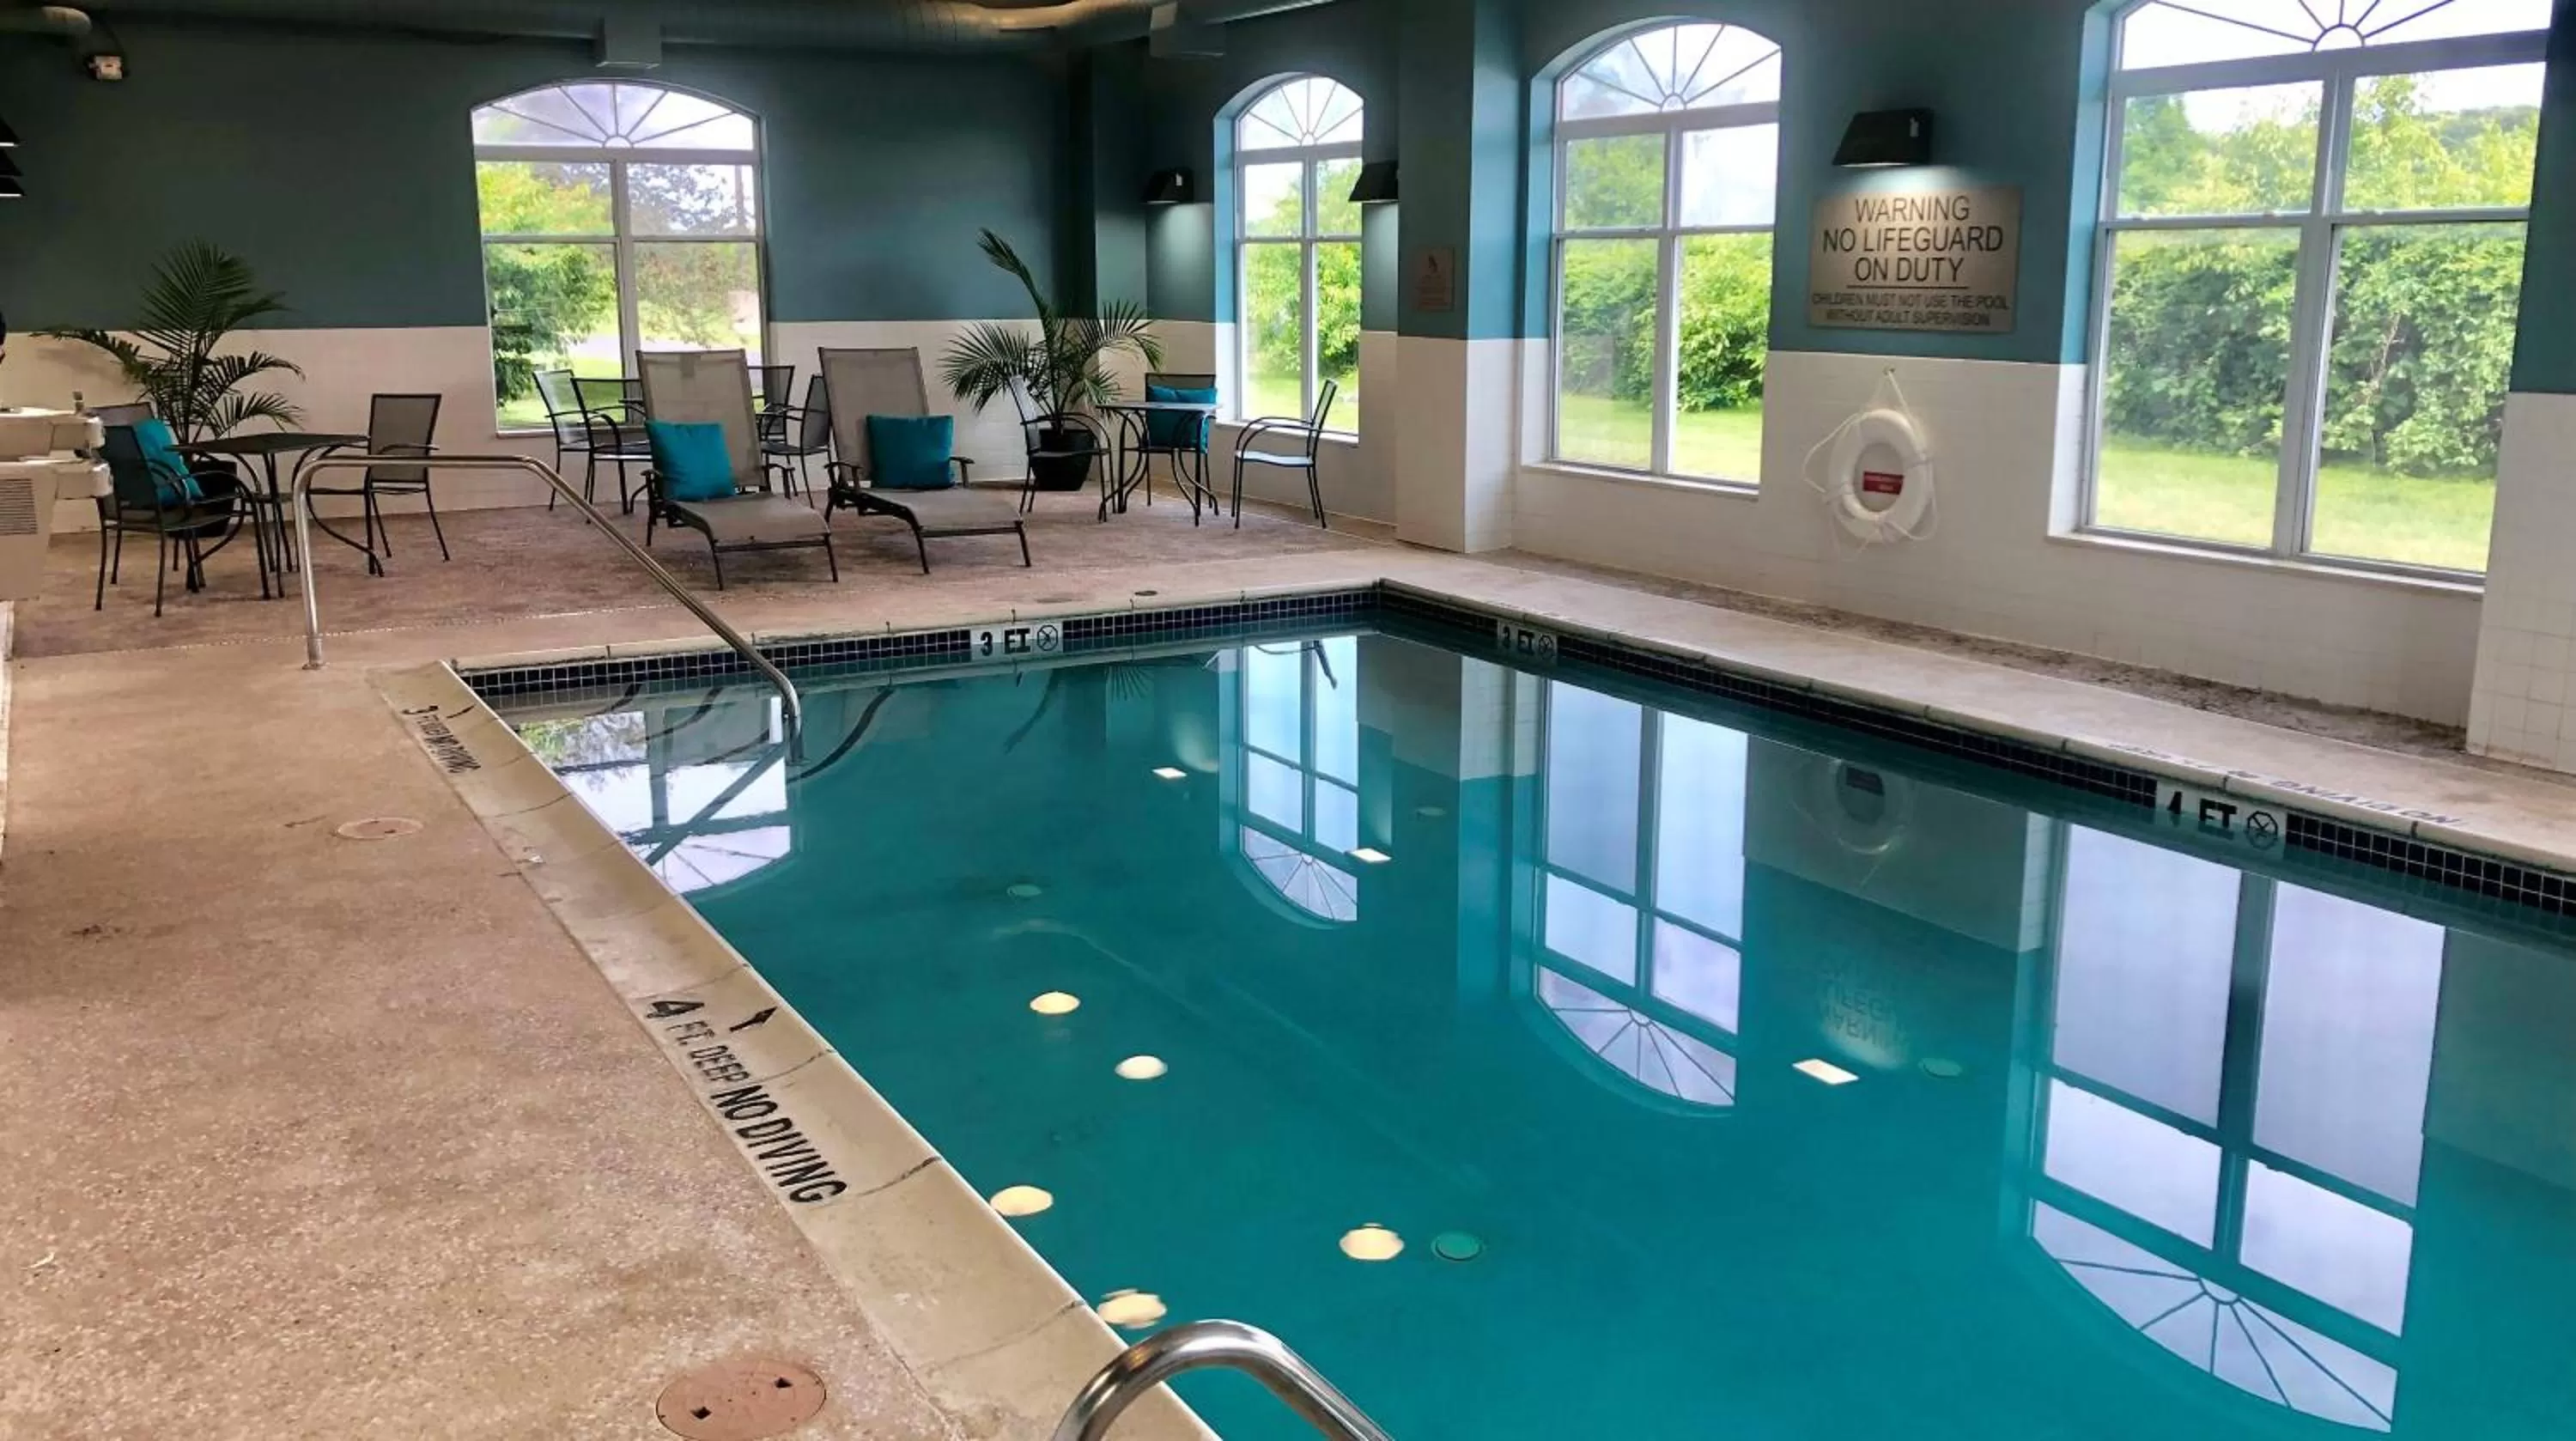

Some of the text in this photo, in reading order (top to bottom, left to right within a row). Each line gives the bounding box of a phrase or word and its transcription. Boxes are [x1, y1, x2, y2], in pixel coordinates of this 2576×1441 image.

[1855, 195, 1970, 223] WARNING
[1822, 226, 2004, 252] NO LIFEGUARD
[1854, 257, 1965, 283] ON DUTY
[1812, 292, 1862, 306] CHILDREN
[1865, 293, 1896, 307] MUST
[1925, 295, 1947, 308] USE
[1950, 295, 1973, 308] THE
[1975, 295, 2010, 311] POOL
[1874, 309, 1911, 324] ADULT
[980, 628, 1031, 655] 3 FT
[2198, 797, 2239, 829] FT
[647, 1000, 705, 1019] 4
[690, 1044, 750, 1082] DEEP
[709, 1084, 779, 1122] NO
[735, 1117, 848, 1203] DIVING
